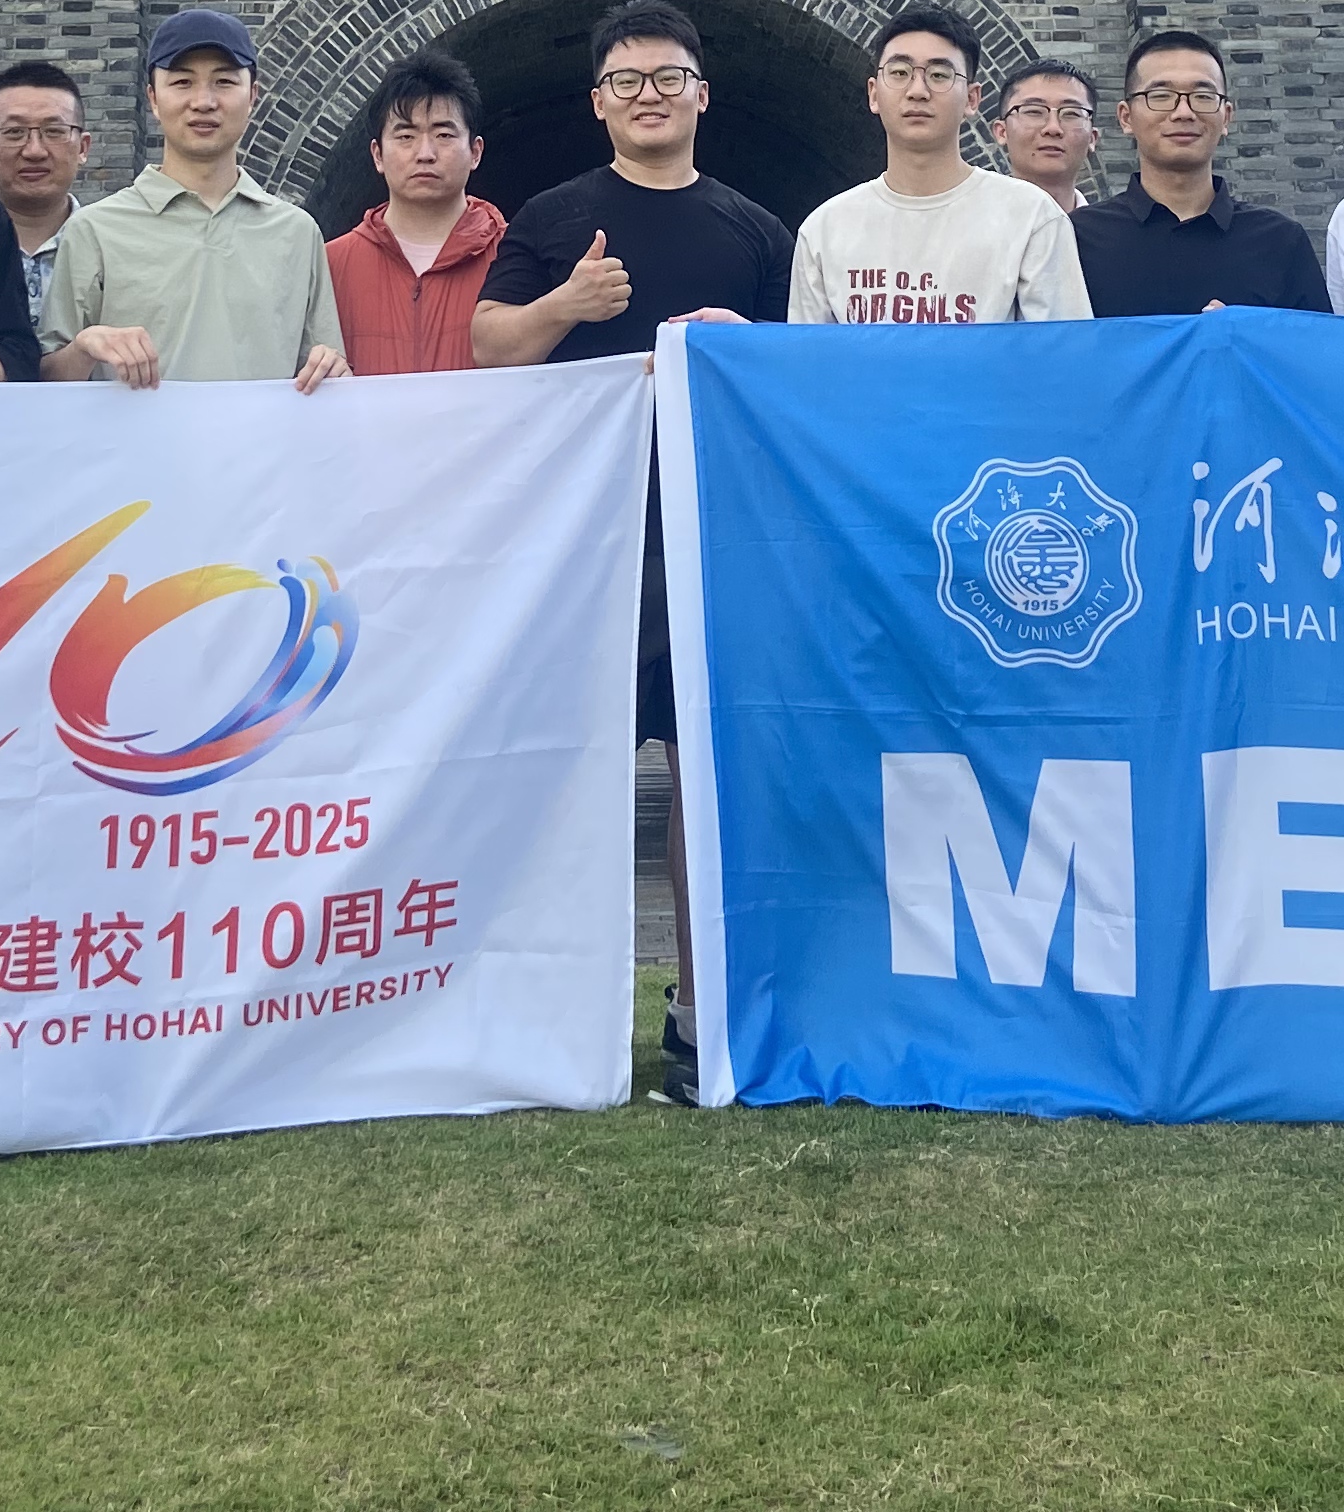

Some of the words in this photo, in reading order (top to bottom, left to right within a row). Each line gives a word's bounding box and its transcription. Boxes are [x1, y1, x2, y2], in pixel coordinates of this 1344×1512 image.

[847, 268, 887, 289] THE
[895, 271, 938, 292] O.G.
[962, 578, 1013, 632] HOHAI
[1017, 577, 1116, 642] UNIVERSITY
[1021, 598, 1059, 612] 1915
[1195, 600, 1338, 646] HOHAI
[99, 796, 372, 869] 1915-2025
[42, 1015, 92, 1046] OF
[104, 1004, 224, 1043] HOHAI
[242, 962, 455, 1027] UNIVERSITY
